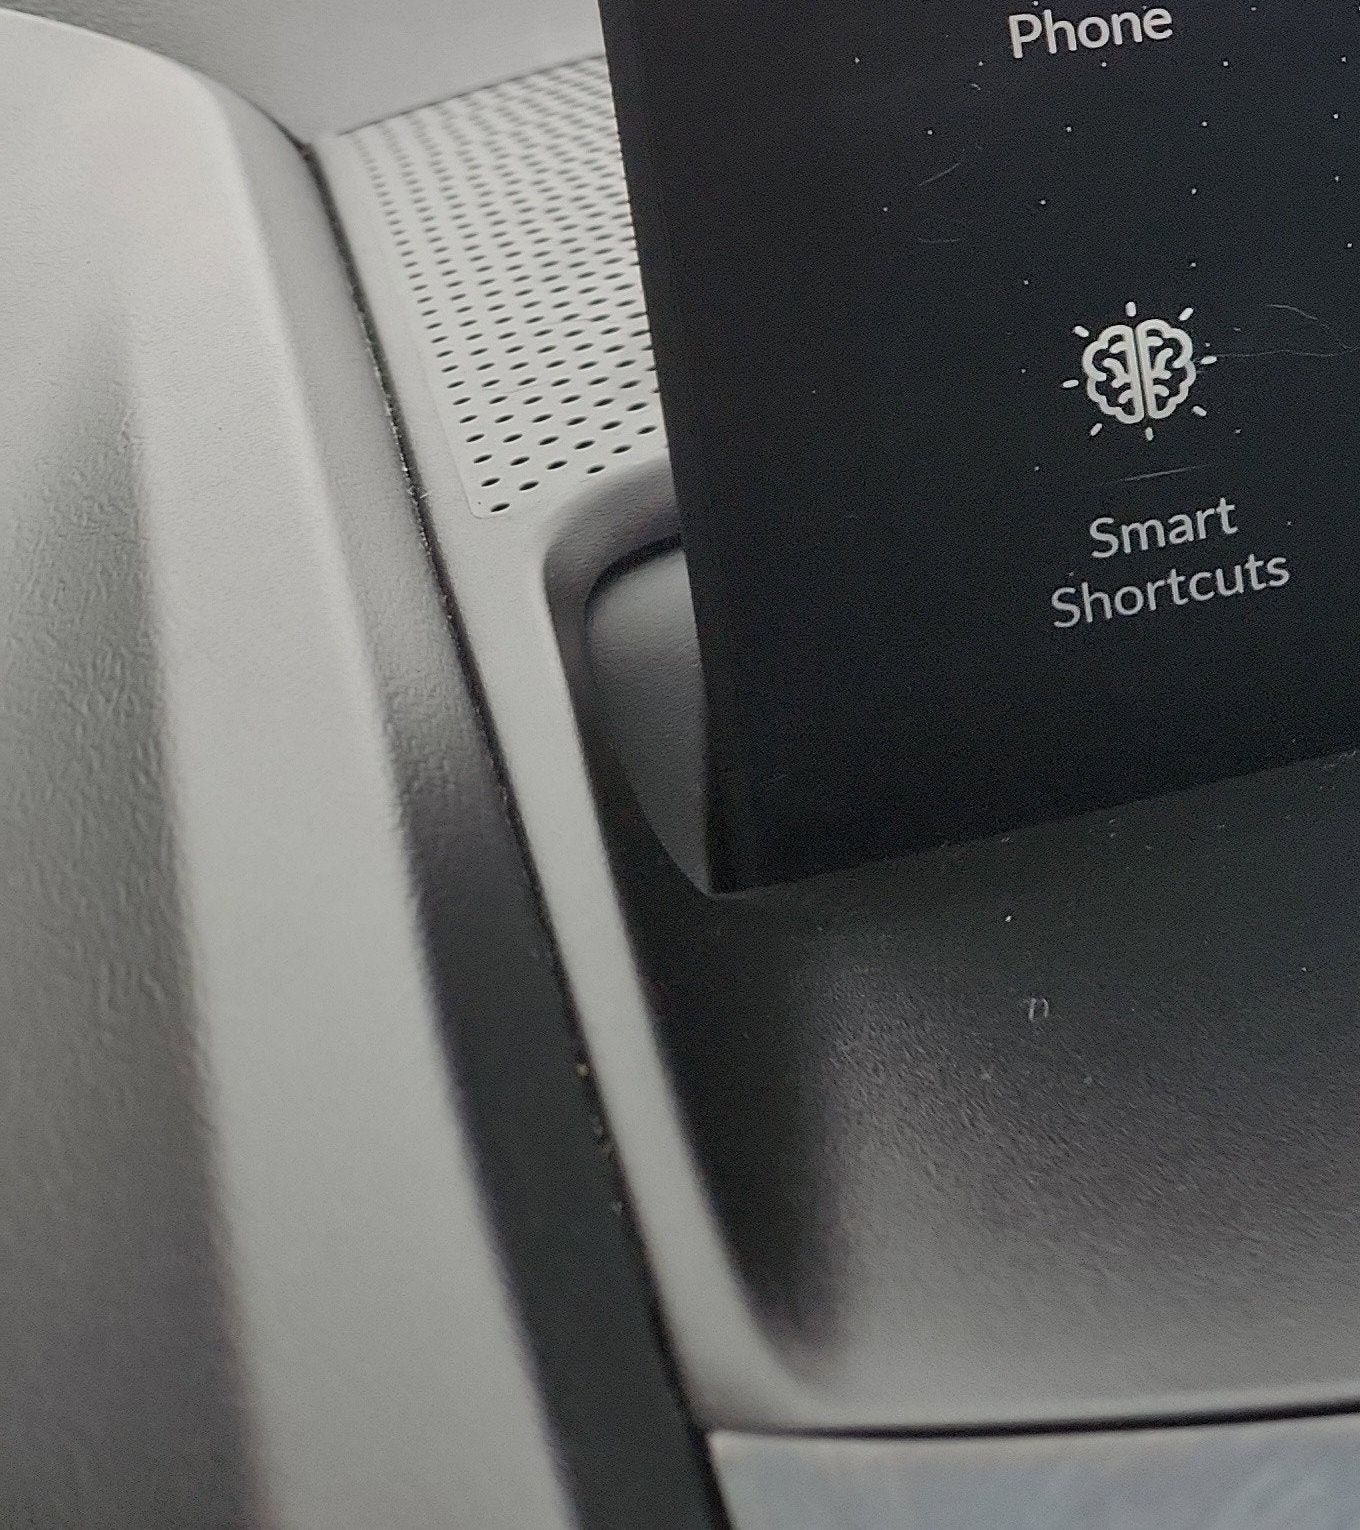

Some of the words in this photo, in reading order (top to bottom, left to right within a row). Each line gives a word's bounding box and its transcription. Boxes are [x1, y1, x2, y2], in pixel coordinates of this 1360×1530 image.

[1008, 8, 1173, 59] Phone
[1089, 497, 1239, 559] Smart
[1051, 553, 1290, 628] Shortcuts
